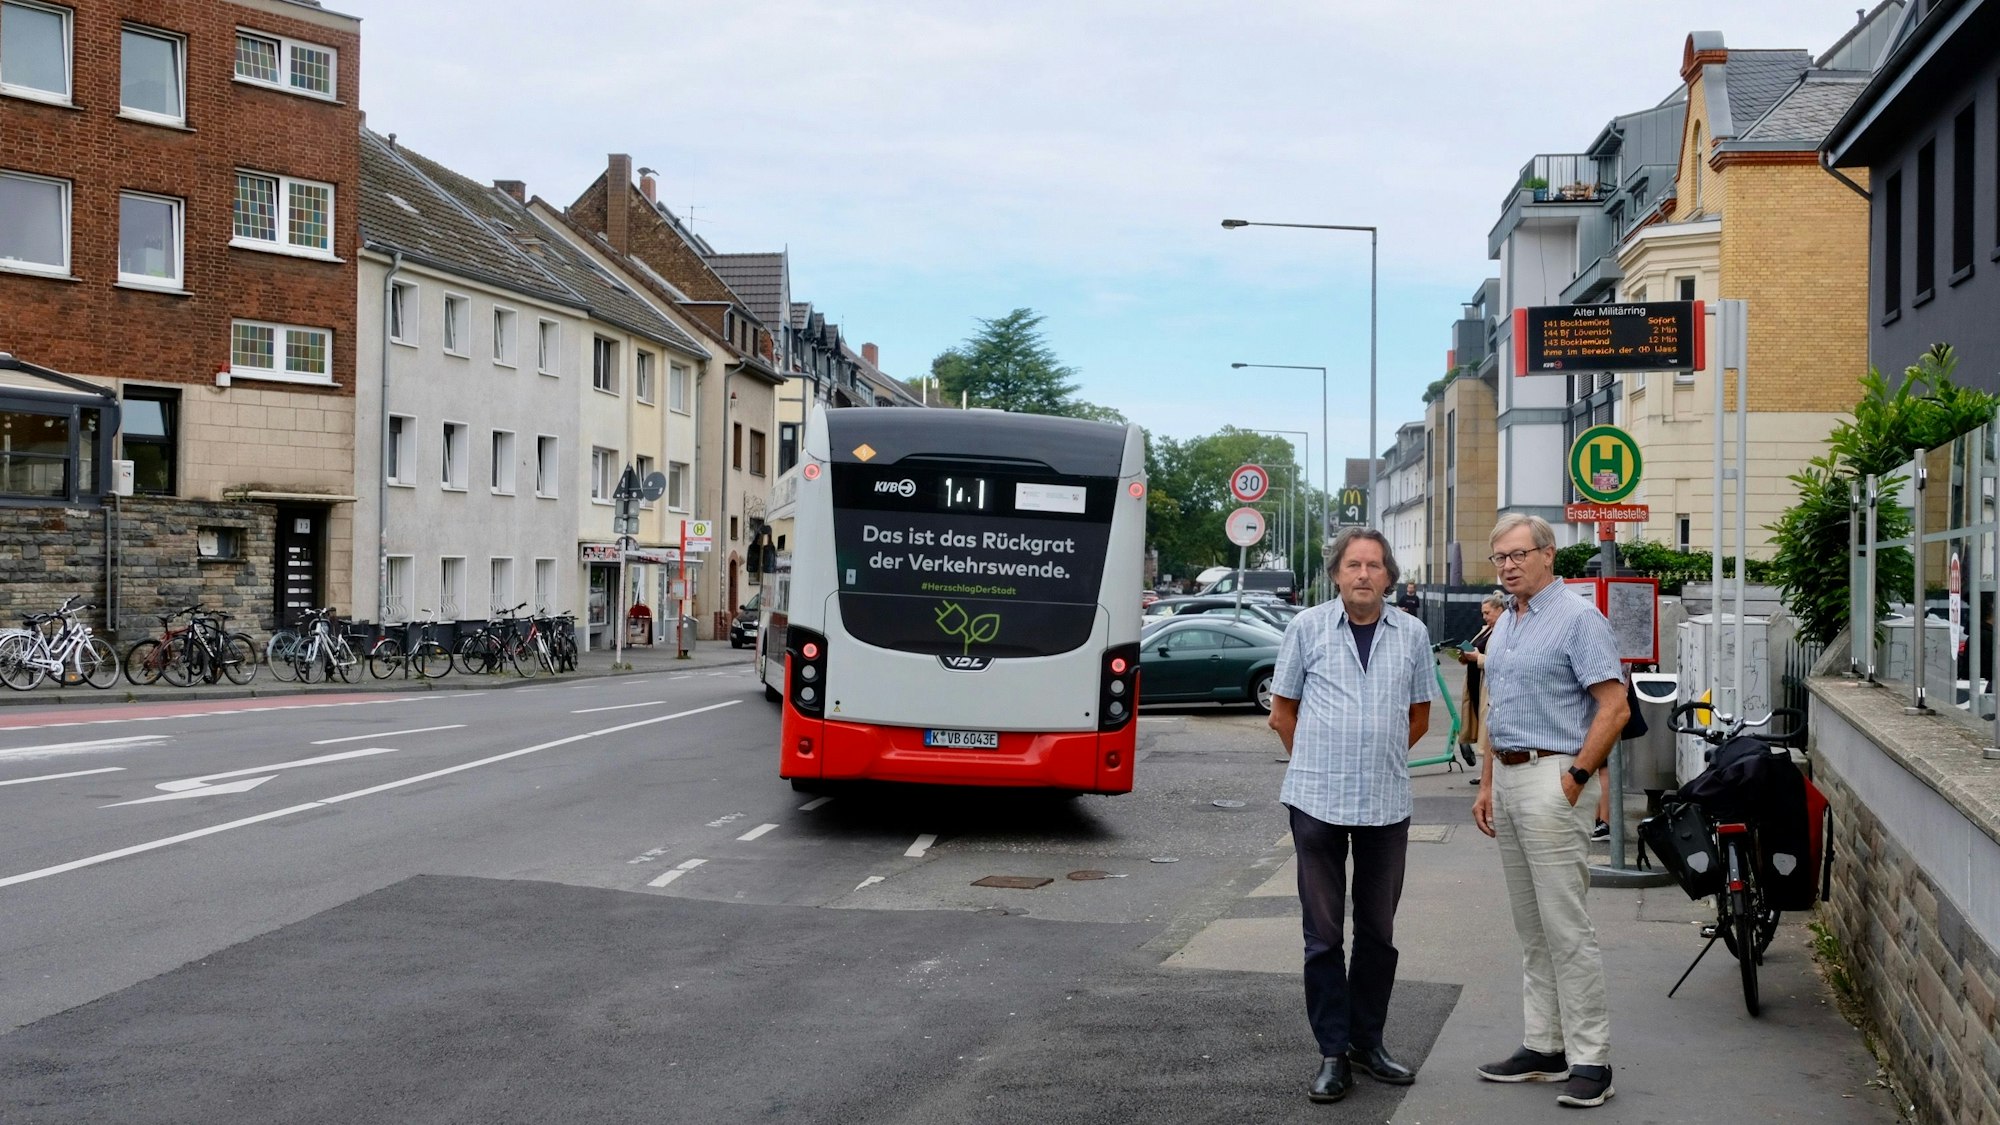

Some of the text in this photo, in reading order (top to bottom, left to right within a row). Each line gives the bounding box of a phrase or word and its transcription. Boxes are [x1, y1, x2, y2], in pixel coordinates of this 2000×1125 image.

[1573, 306, 1646, 317] Alter Militärring
[1543, 316, 1676, 328] 141 Bocklemünd Sofort
[1543, 326, 1677, 338] 144 Bf Lövenich 2 Min
[1543, 339, 1558, 347] 143
[1560, 338, 1610, 346] Bocklemünd
[1648, 336, 1659, 344] 12
[1567, 348, 1578, 356] im
[1582, 346, 1615, 355] Bereich
[1619, 346, 1634, 354] der
[1654, 345, 1677, 353] Wass
[1590, 444, 1623, 485] H
[874, 481, 899, 493] KVB
[1238, 475, 1260, 492] 30
[1567, 507, 1647, 520] Ersatz-Haltestelle
[863, 525, 1075, 555] Das ist das Rückgrat
[869, 551, 1071, 579] der Verkehrswende.
[921, 582, 1017, 595] #HerzschlagDerStadt
[946, 657, 984, 668] VDL
[932, 731, 996, 746] K VB 6043E
